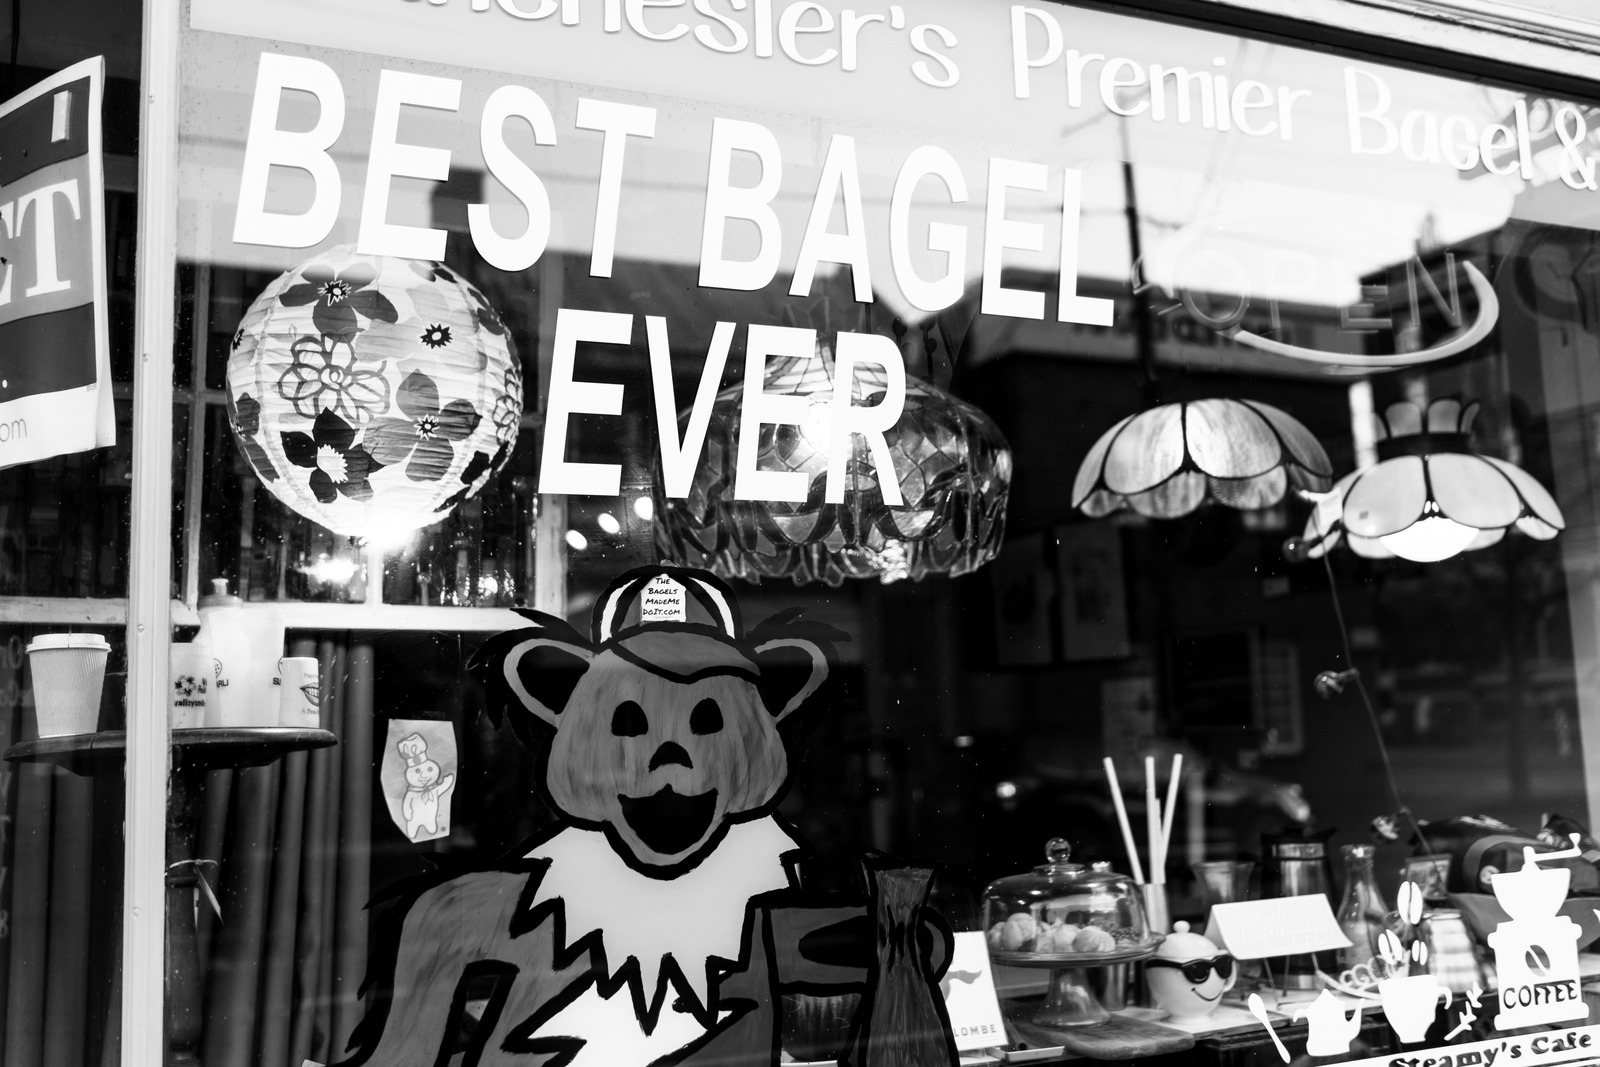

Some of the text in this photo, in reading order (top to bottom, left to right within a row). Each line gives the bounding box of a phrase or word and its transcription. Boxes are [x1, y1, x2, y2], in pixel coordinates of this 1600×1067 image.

[1011, 5, 1312, 140] Premier
[1554, 106, 1599, 191] &
[233, 52, 1115, 326] BEST BAGEL
[1179, 250, 1462, 330] OPEN
[538, 308, 905, 506] EVER
[656, 577, 670, 585] THE
[1503, 981, 1578, 1009] COFFEE
[1531, 1032, 1592, 1055] Cafe
